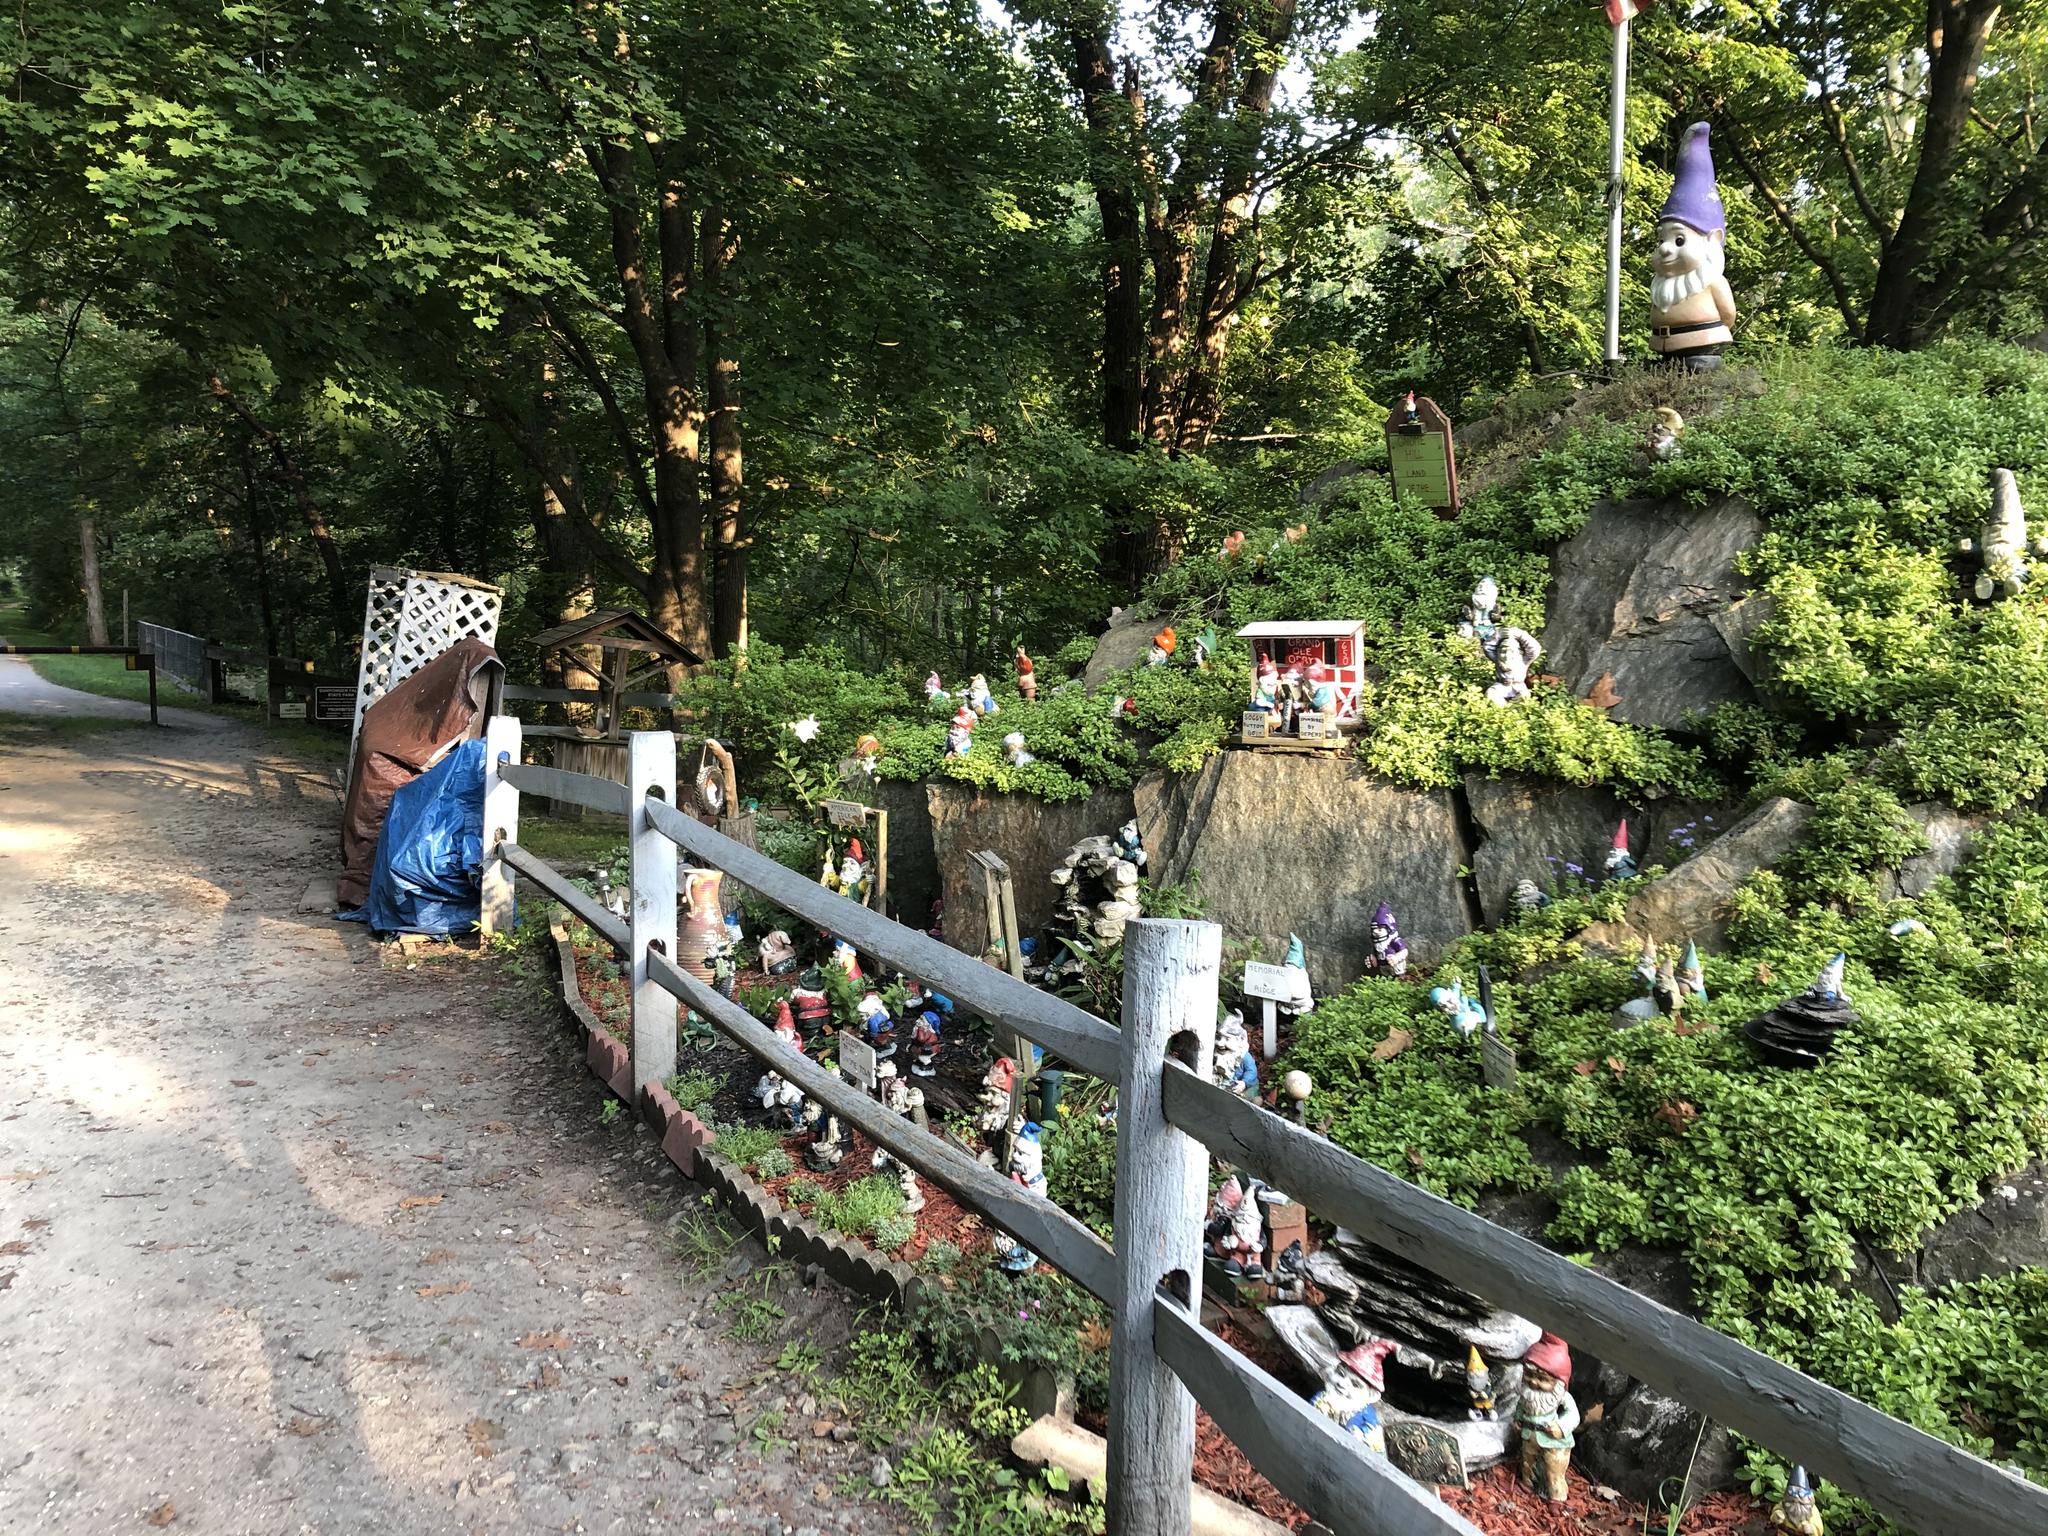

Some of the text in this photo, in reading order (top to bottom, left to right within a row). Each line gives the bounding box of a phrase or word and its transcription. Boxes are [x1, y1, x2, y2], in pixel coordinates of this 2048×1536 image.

[1406, 469, 1426, 477] LAND
[1288, 638, 1321, 648] GRAND
[1292, 647, 1312, 656] OLE
[831, 804, 858, 813] AMERICAN
[1247, 965, 1286, 977] MEMORIAL
[1254, 985, 1276, 995] RIDGE
